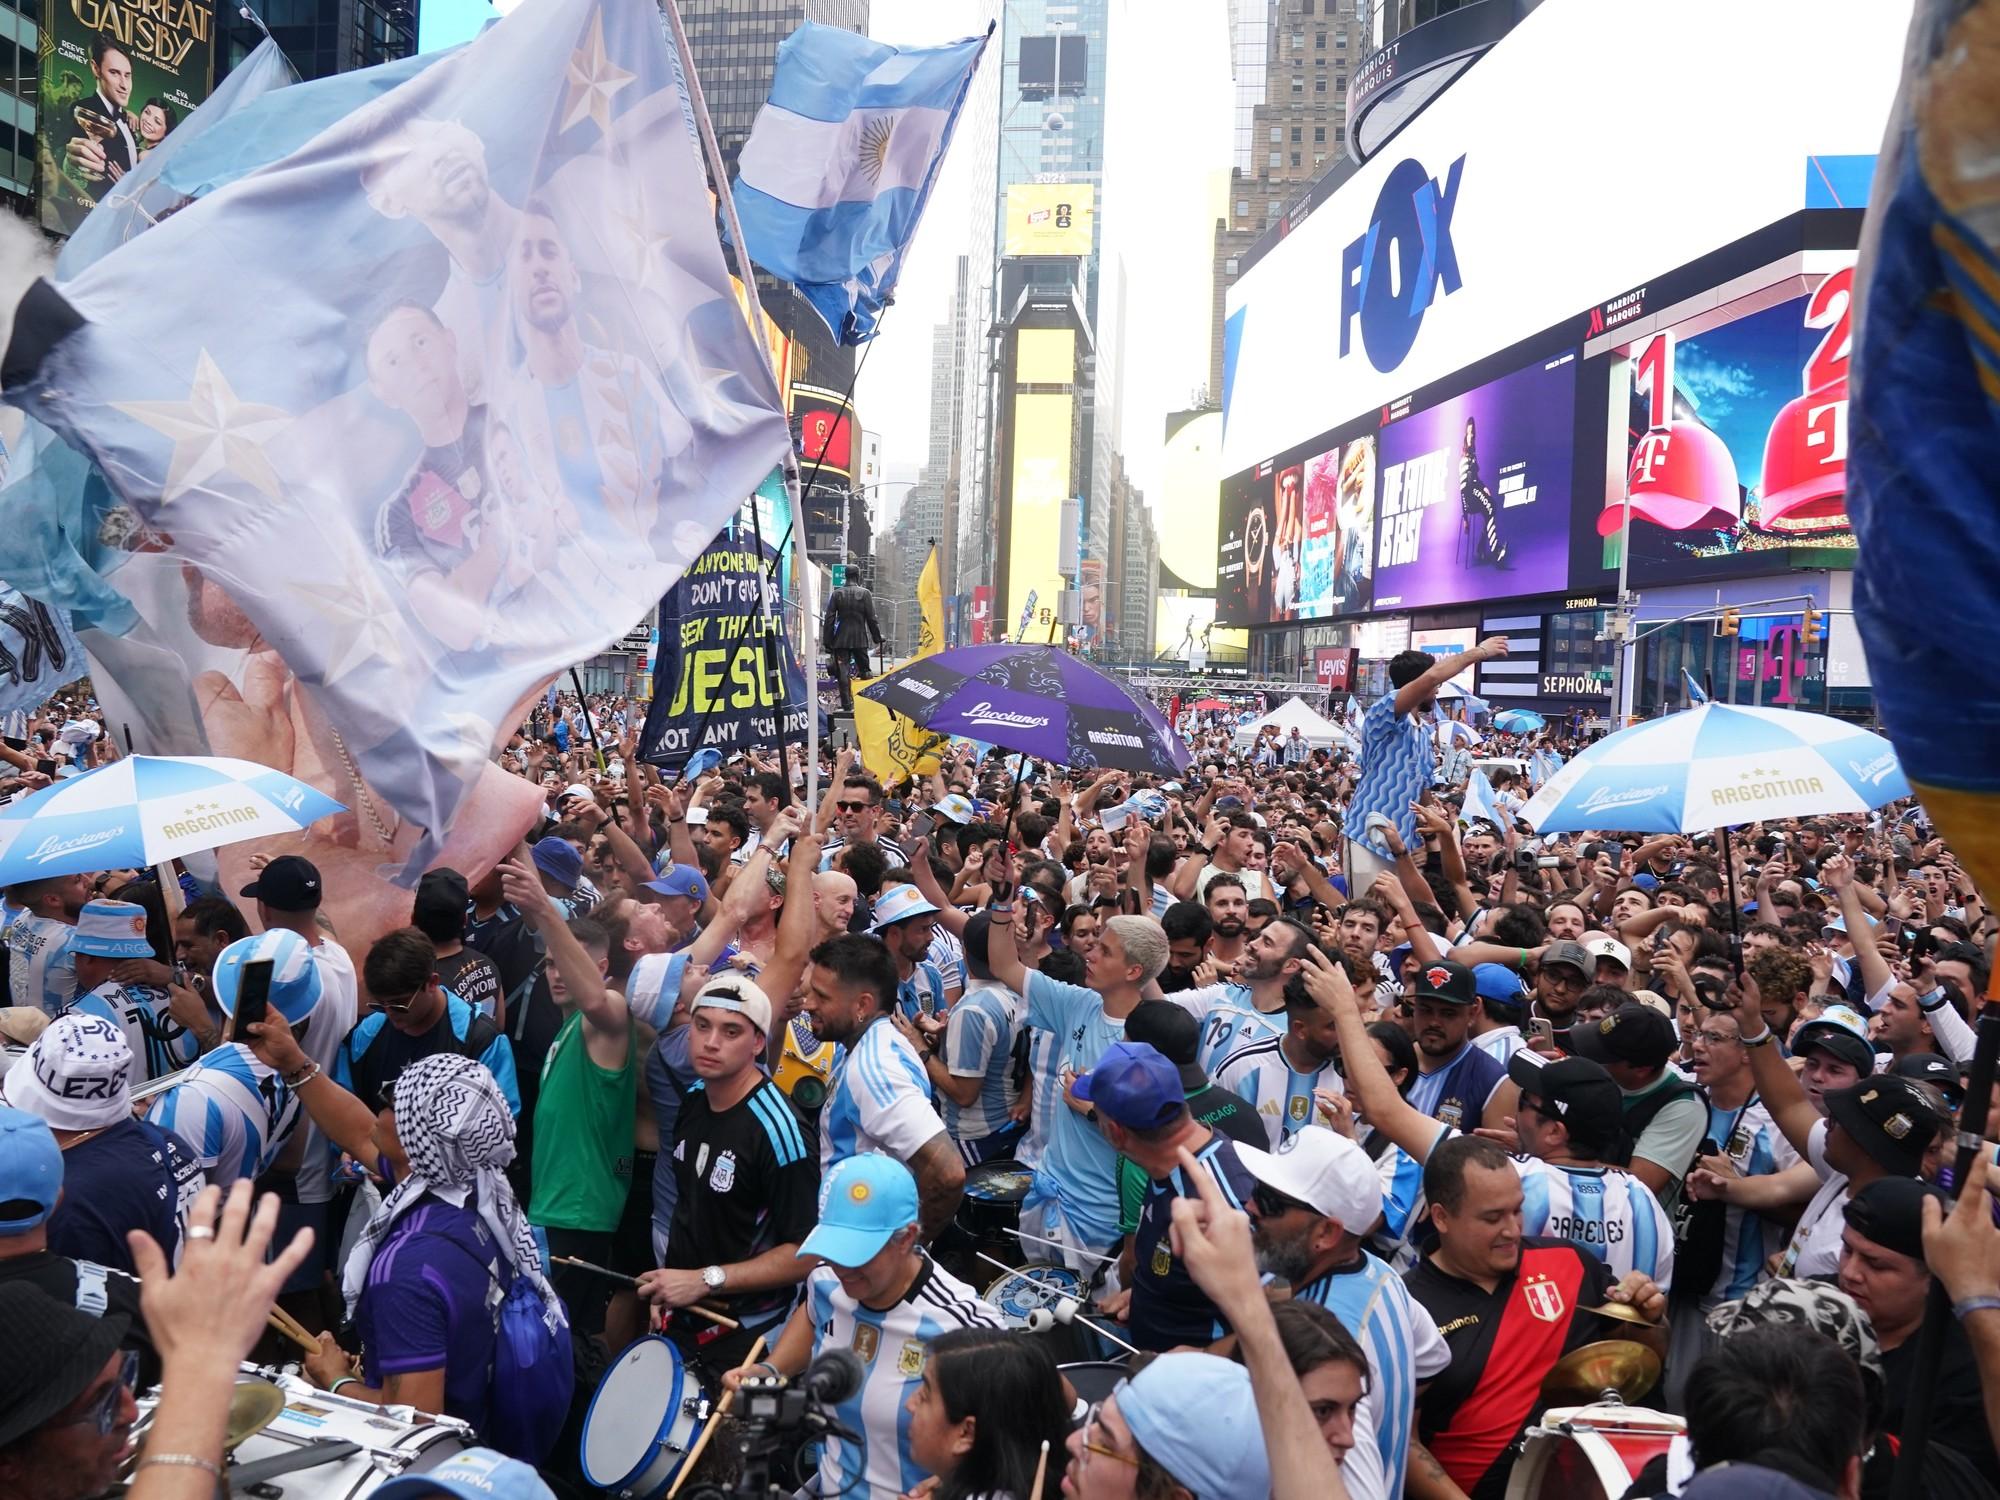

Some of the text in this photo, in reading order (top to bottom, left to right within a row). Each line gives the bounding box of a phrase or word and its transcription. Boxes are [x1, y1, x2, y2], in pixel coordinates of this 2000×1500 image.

[58, 47, 89, 65] CARNEY
[61, 40, 85, 56] REEVE
[136, 52, 151, 62] NEW
[152, 59, 180, 76] MUSICAL
[1355, 42, 1400, 88] MARRIOTT
[176, 89, 189, 100] EVA
[1355, 64, 1393, 103] MARQUIS
[1339, 152, 1467, 374] FOX
[1606, 287, 1646, 314] MARRIOTT
[1606, 303, 1641, 326] MARQUIS
[691, 575, 737, 606] DON'T
[1565, 597, 1598, 609] SEPHORA
[1543, 676, 1603, 694] SEPHORA
[961, 701, 1050, 730] Lucciano's
[702, 721, 740, 745] ANY
[1088, 730, 1145, 749] ARGENTINA
[1711, 777, 1825, 807] ARGENTINA
[162, 806, 260, 840] ARGENTINA
[26, 825, 126, 865] Lucciano's
[454, 979, 468, 996] LOS
[483, 965, 493, 976] DE
[473, 977, 498, 996] YORK
[103, 984, 170, 1010] MESS
[32, 1043, 130, 1100] ALLERES
[1199, 1103, 1238, 1124] HICAGO
[1576, 1183, 1601, 1194] 1893
[1437, 1314, 1480, 1335] arathon
